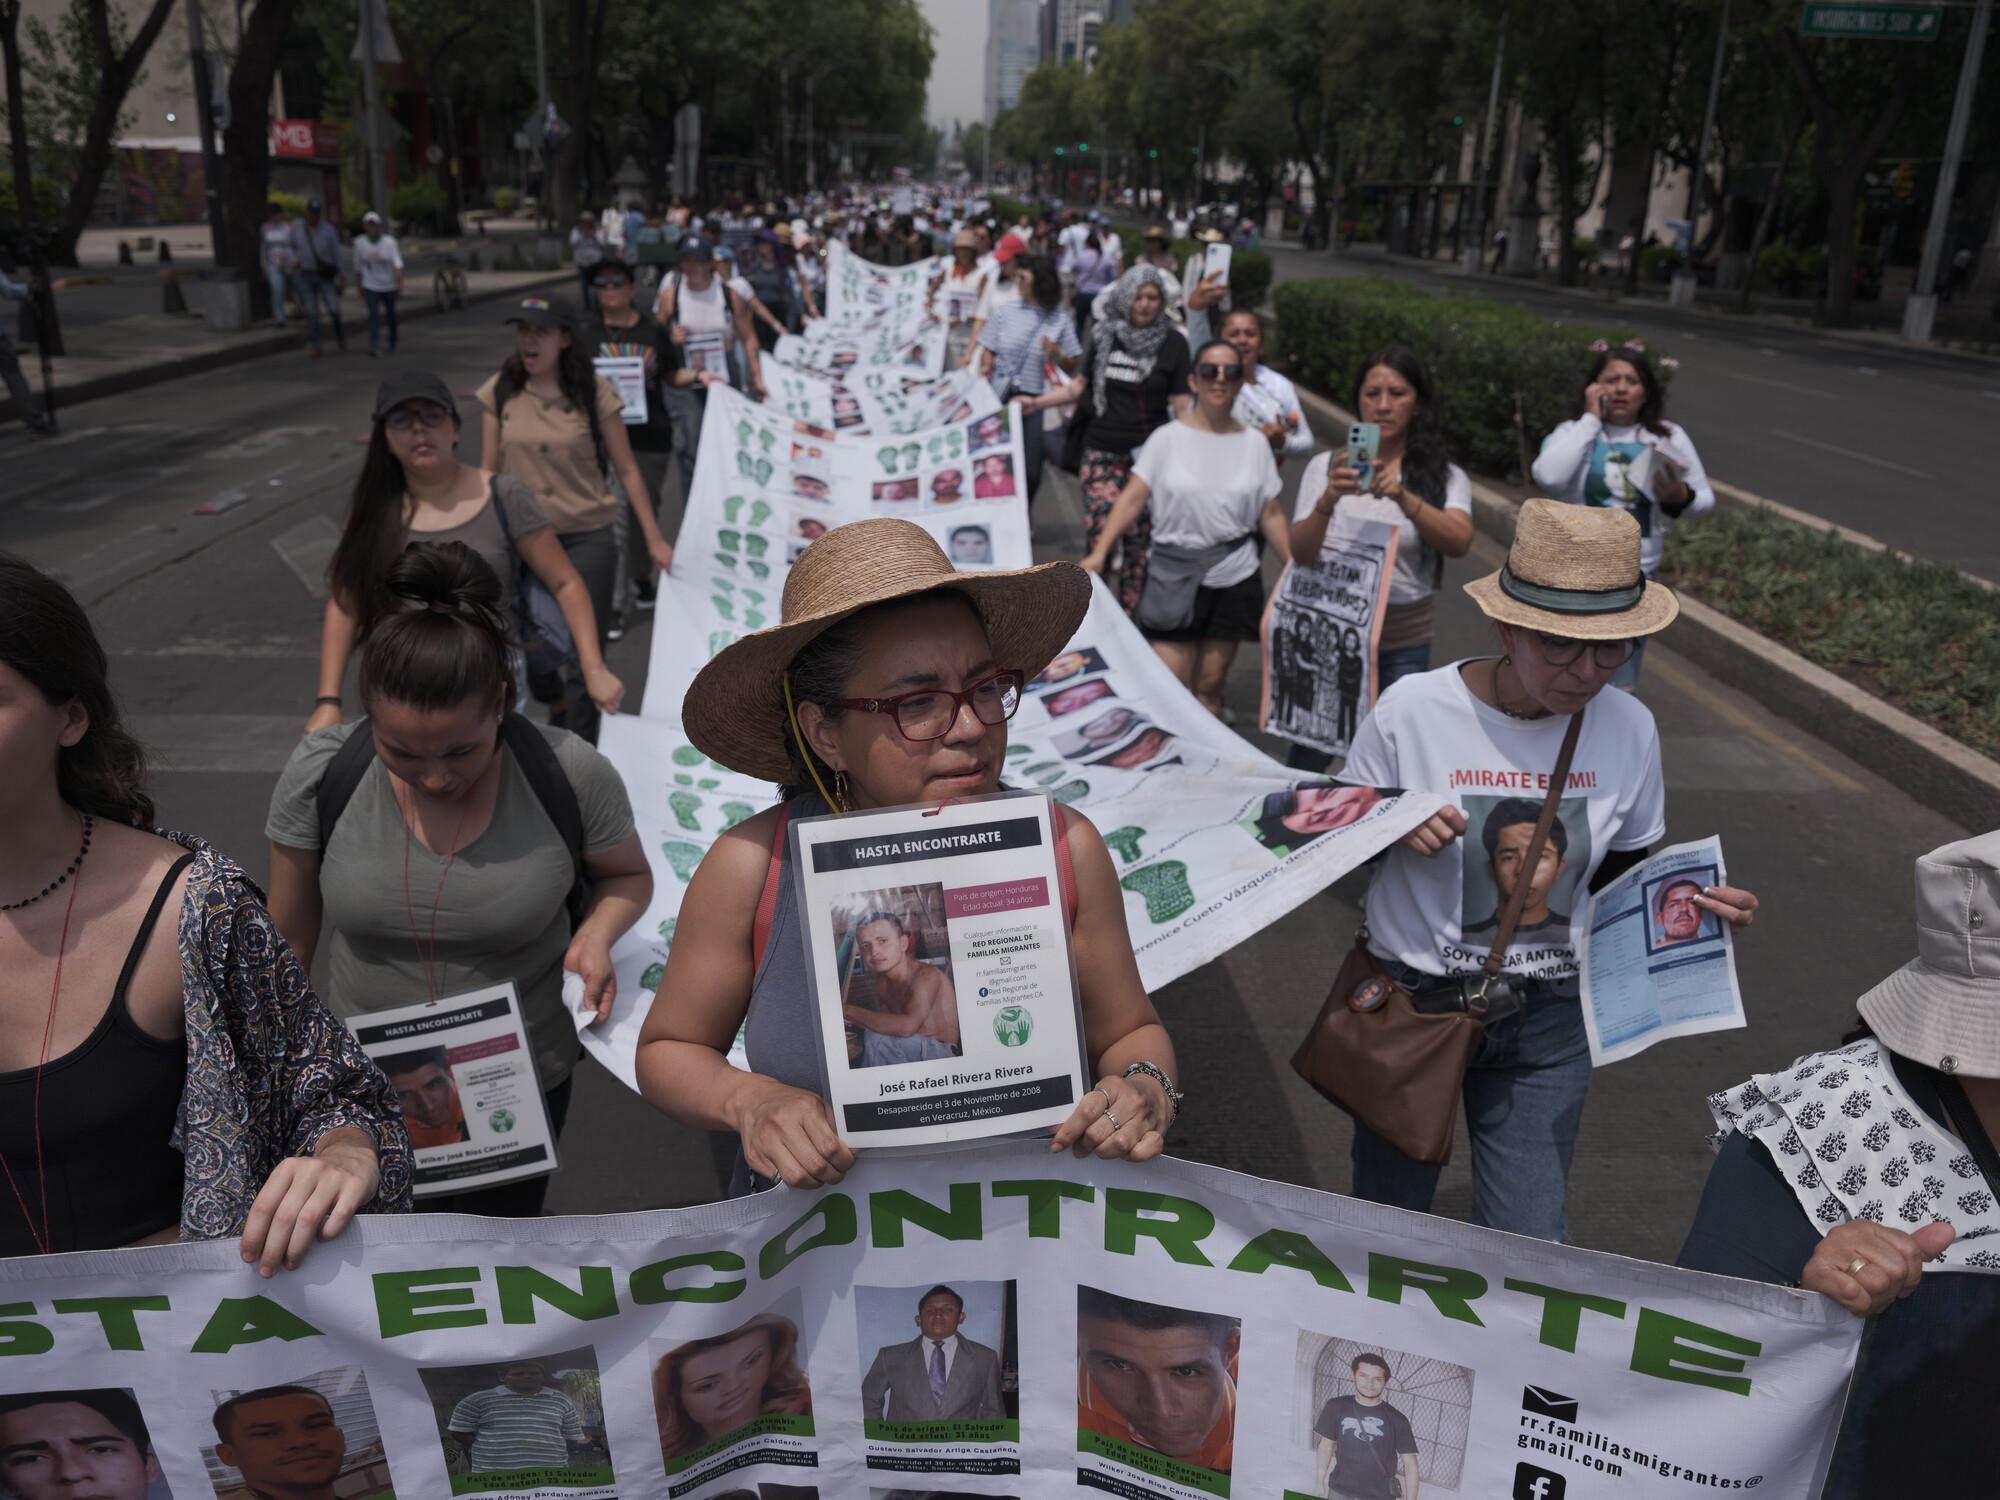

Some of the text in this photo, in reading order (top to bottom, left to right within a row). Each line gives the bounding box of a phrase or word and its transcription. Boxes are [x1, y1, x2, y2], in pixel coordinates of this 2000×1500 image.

[1888, 13, 1912, 32] SUR
[1449, 770, 1597, 790] ¡MIRATE E MI!
[855, 830, 1002, 860] HASTA ENCONTRARTE
[970, 891, 979, 899] de
[979, 888, 1004, 900] origen:
[1005, 883, 1040, 895] Honduras
[962, 902, 981, 912] Edad
[1016, 895, 1033, 904] años
[1134, 925, 1182, 955] erenice
[1182, 901, 1224, 929] Cueto
[1225, 863, 1284, 904] Vázquez,
[963, 926, 994, 940] Cualquier
[995, 923, 1033, 936] información
[967, 942, 1041, 959] FAMILIAS MIGRANTES
[972, 940, 986, 948] RED
[987, 935, 1023, 946] REGIONAL
[1442, 945, 1473, 964] SOY
[976, 963, 1037, 977] rr.familiasmigrantes
[989, 981, 1038, 995] Red Regional de
[976, 990, 1045, 1007] Familias Migrantes CA
[385, 1009, 483, 1037] HASTA ENCONTRARTE
[879, 1063, 1034, 1096] José Rafael Rivera Rivera
[877, 1085, 1041, 1115] Desaparecido el 3 de Noviembre de 2008
[920, 1105, 1003, 1124] en Veracruz, México.
[419, 1156, 446, 1165] Wilker
[447, 1151, 464, 1161] José
[484, 1140, 519, 1154] Carrasco
[372, 1179, 1761, 1396] ENCONTRARTE
[894, 1432, 917, 1440] Edad
[920, 1432, 951, 1440] actual:
[916, 1425, 949, 1434] origen:
[764, 1438, 803, 1447] Calderón
[868, 1445, 903, 1454] Gustavo
[945, 1447, 971, 1455] Artiga
[868, 1457, 922, 1466] Desaparecido
[1106, 1448, 1127, 1462] Edad
[1130, 1457, 1161, 1473] actual:
[1517, 1432, 1623, 1477] gmail.com
[1520, 1414, 1764, 1492] rr.familiasmigrantes@
[964, 1465, 993, 1474] México
[1098, 1461, 1125, 1474] Wilker
[1127, 1471, 1146, 1483] José
[1117, 1444, 1127, 1453] de
[1130, 1449, 1163, 1466] origen:
[1166, 1460, 1214, 1482] Nicaragua
[1082, 1470, 1135, 1492] Desaparecido
